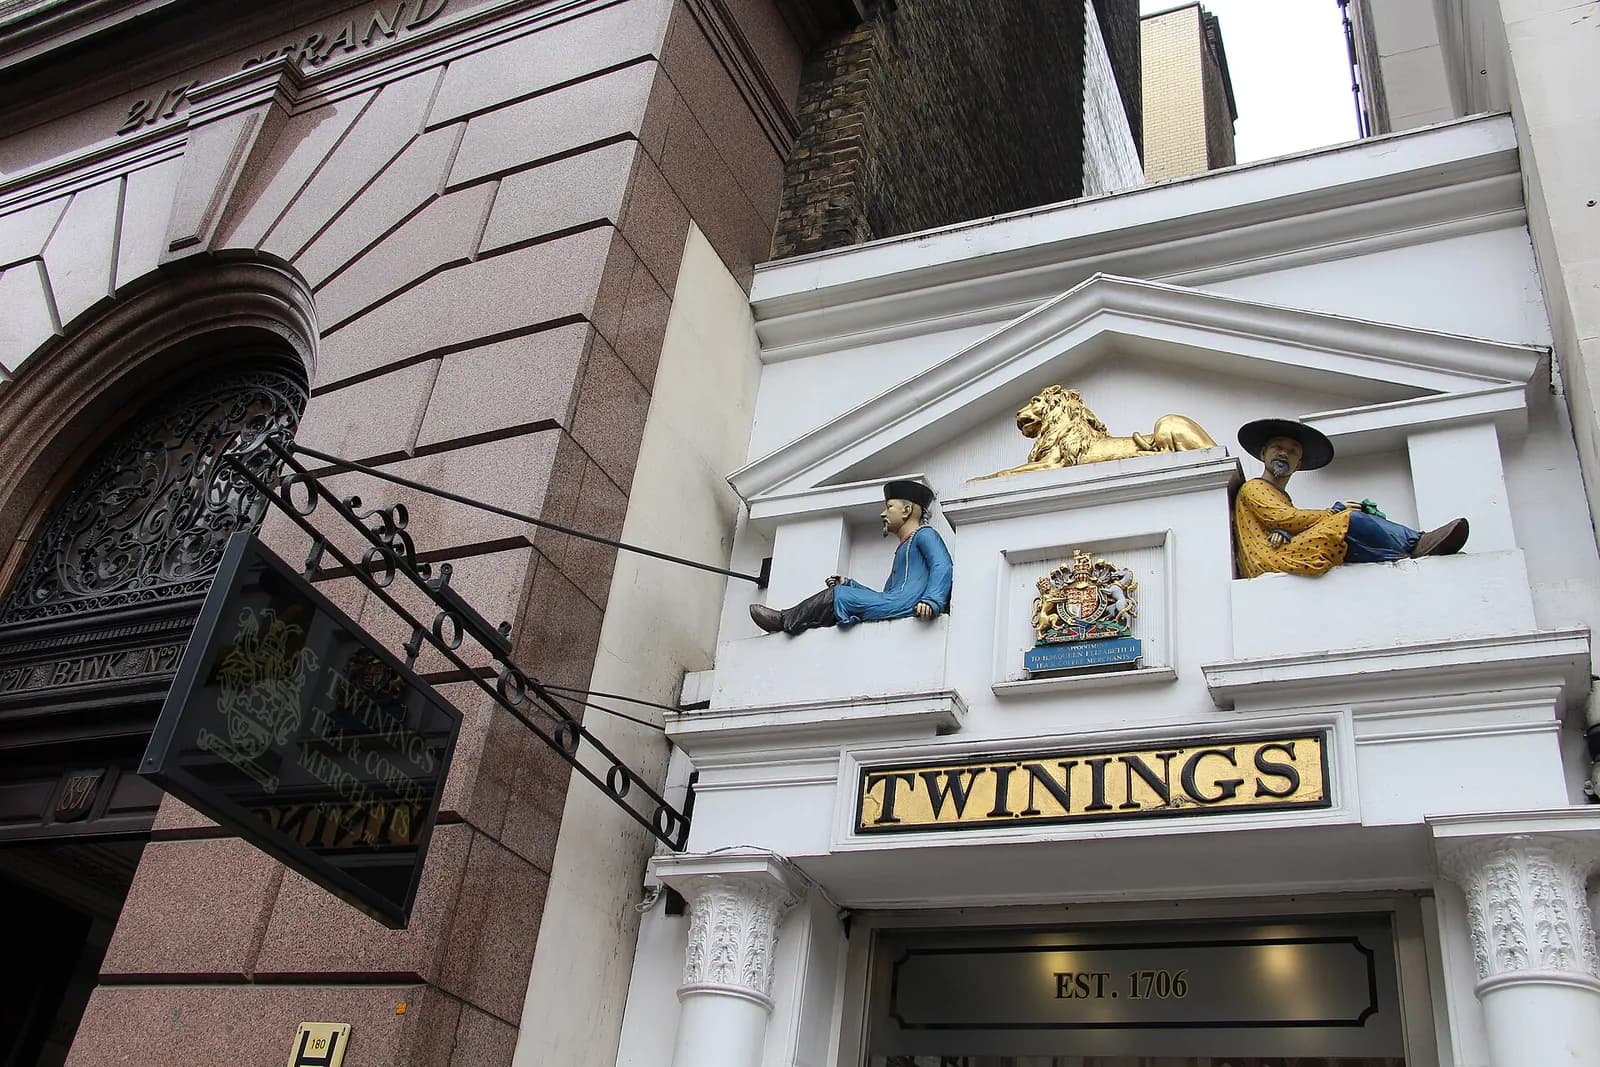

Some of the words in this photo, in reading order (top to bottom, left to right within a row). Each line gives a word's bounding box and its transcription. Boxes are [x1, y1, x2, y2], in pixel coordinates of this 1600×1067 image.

[116, 79, 199, 136] 217
[50, 653, 124, 686] BANK
[327, 666, 437, 775] TWININGS
[312, 705, 345, 748] TEA
[348, 737, 362, 765] &
[365, 750, 424, 805] COFFEE
[866, 742, 1301, 825] TWININGS
[1053, 970, 1119, 999] EST.
[1127, 968, 1188, 999] 1706
[311, 1039, 326, 1050] 180
